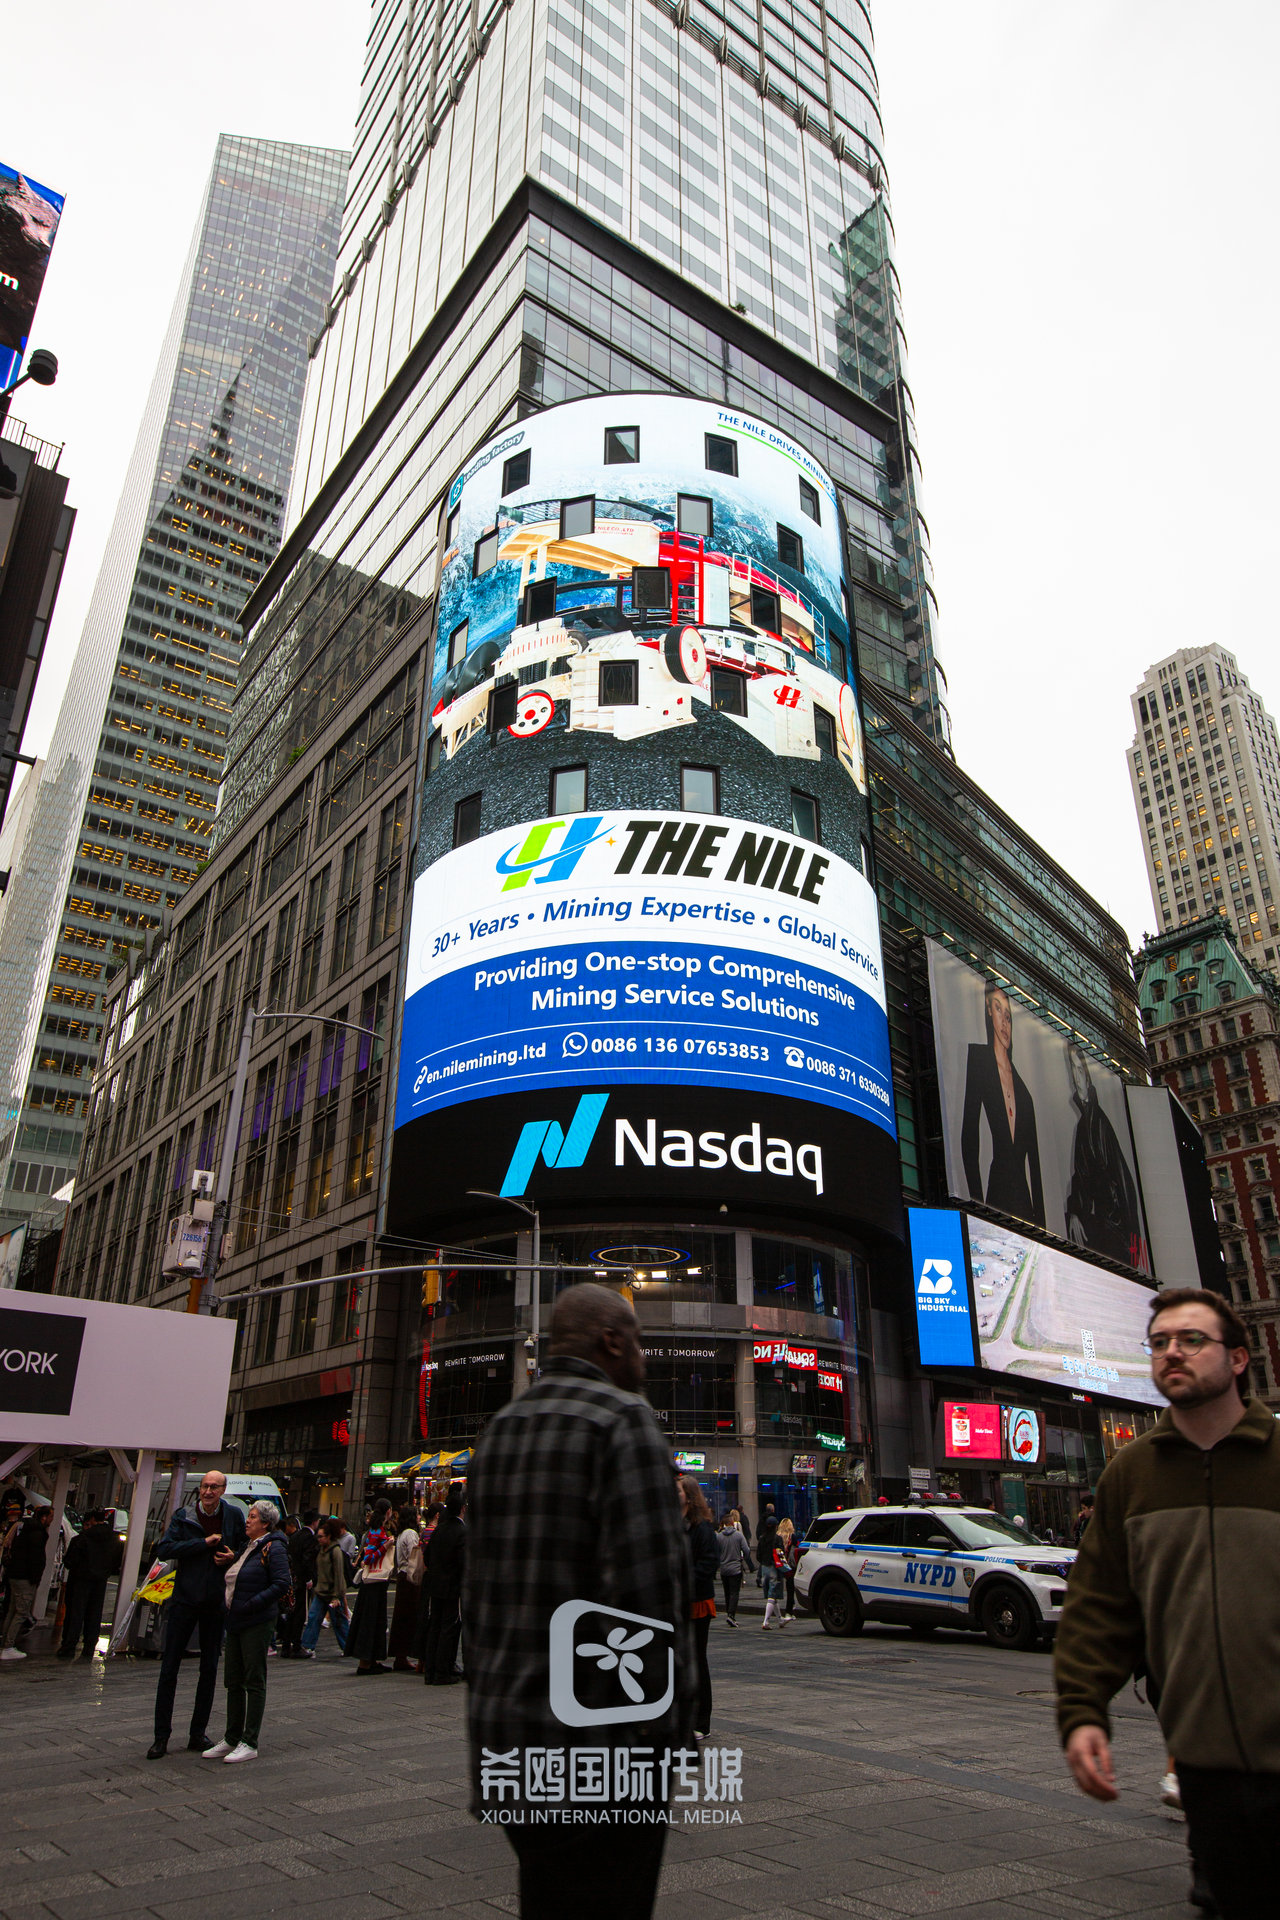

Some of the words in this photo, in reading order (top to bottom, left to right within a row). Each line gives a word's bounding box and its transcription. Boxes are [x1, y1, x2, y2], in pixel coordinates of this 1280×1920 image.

[492, 434, 522, 457] factory
[717, 412, 740, 426] THE
[742, 421, 766, 437] NILE
[768, 433, 801, 460] DRIVES
[803, 457, 830, 489] MINING
[614, 821, 730, 878] THE
[724, 831, 830, 905] NILE
[432, 932, 460, 957] 30+
[469, 912, 519, 940] Years
[543, 897, 632, 921] Mining
[641, 897, 755, 925] Expertise
[778, 915, 836, 950] Global
[840, 938, 879, 981] Service
[474, 957, 577, 991] Providing
[585, 951, 701, 978] One-stop
[708, 955, 856, 1011] Comprehensive
[531, 985, 616, 1011] Mining
[625, 984, 715, 1006] Service
[721, 988, 820, 1026] Solutions
[426, 1042, 546, 1084] en.nilemining.ltd
[591, 1037, 637, 1053] 0086
[644, 1037, 678, 1053] 136
[683, 1039, 770, 1062] 07653853
[806, 1056, 836, 1077] 0086
[839, 1066, 857, 1085] 371
[614, 1118, 824, 1196] Nasdaq
[918, 1304, 968, 1313] INDUSTRIAL
[934, 1297, 951, 1305] SKY
[444, 1358, 466, 1367] REWRITE
[469, 1353, 505, 1364] TOMORROW
[640, 1349, 664, 1357] WRITE
[668, 1349, 716, 1358] TOMORROW
[904, 1562, 957, 1588] NYPD
[985, 1556, 1007, 1564] POLICE
